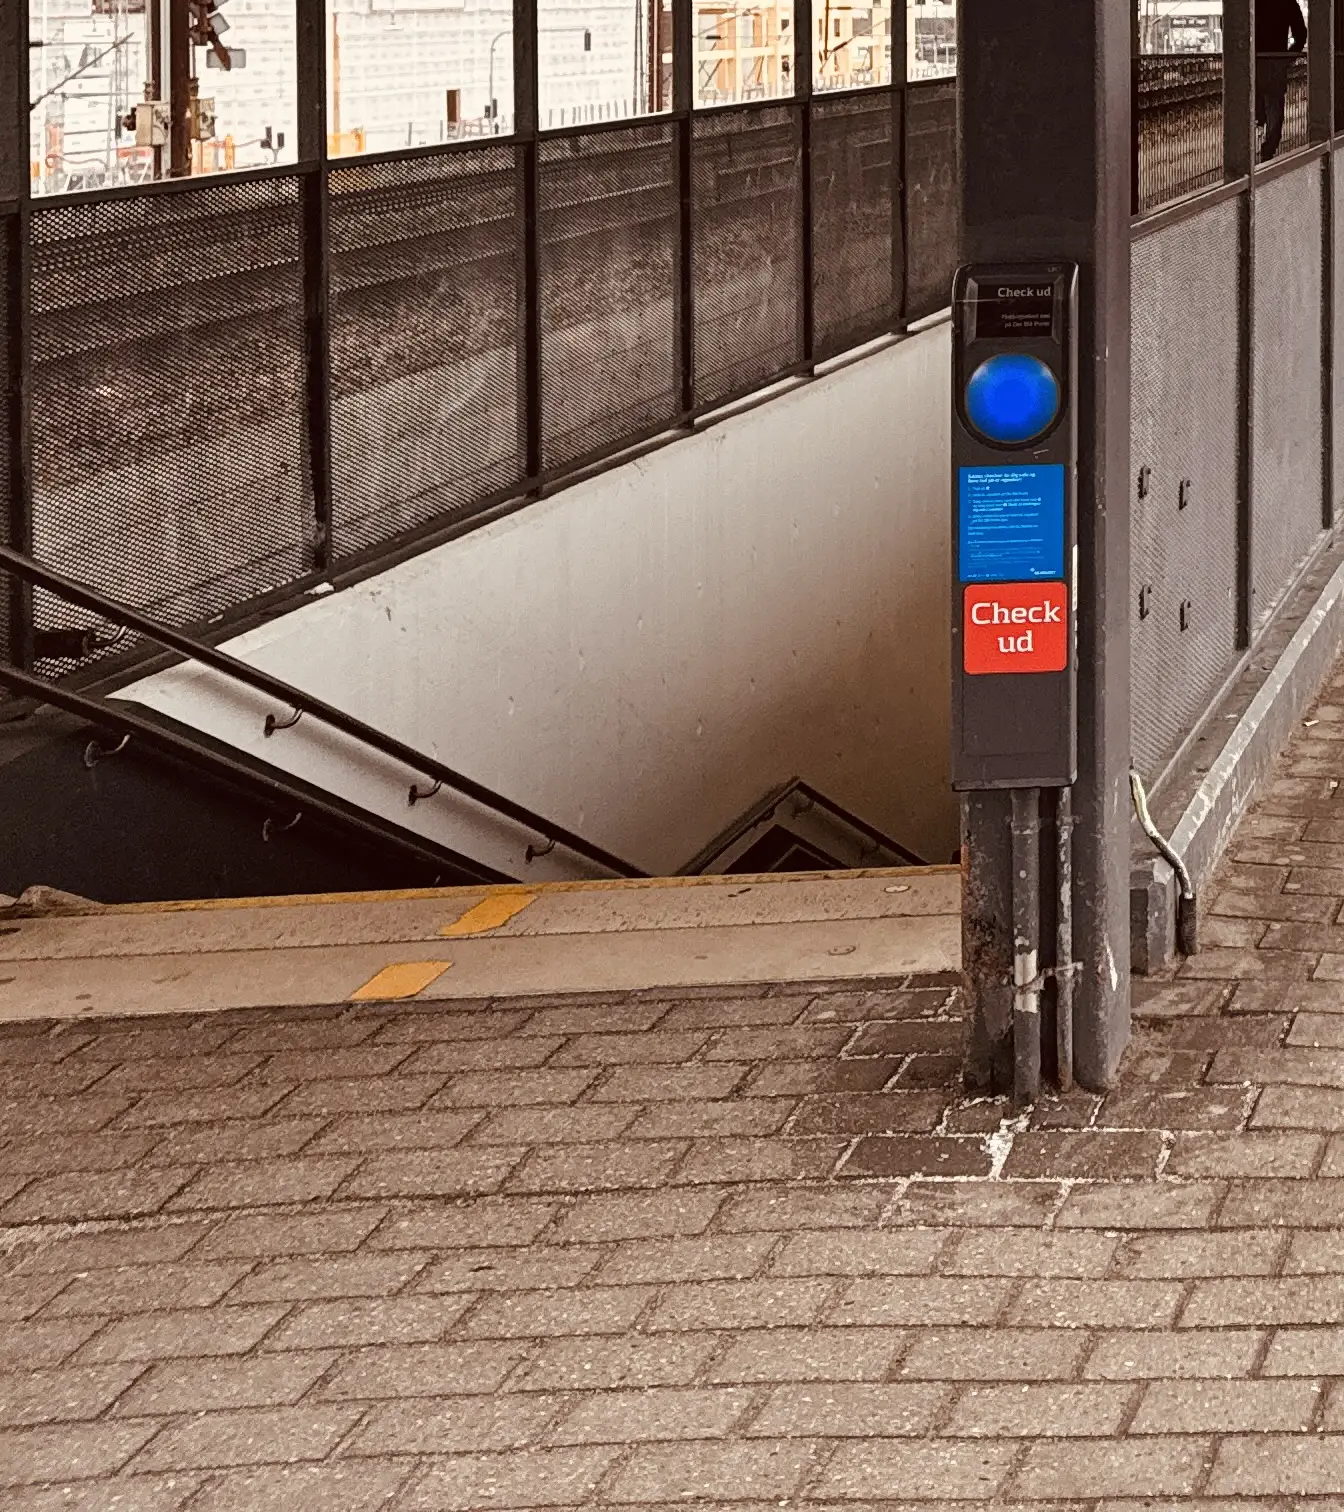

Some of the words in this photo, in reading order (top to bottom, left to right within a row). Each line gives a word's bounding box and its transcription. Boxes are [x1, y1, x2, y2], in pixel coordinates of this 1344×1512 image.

[997, 287, 1034, 298] Check
[1036, 286, 1051, 297] ud
[971, 600, 1061, 626] Check
[997, 630, 1034, 653] ud
